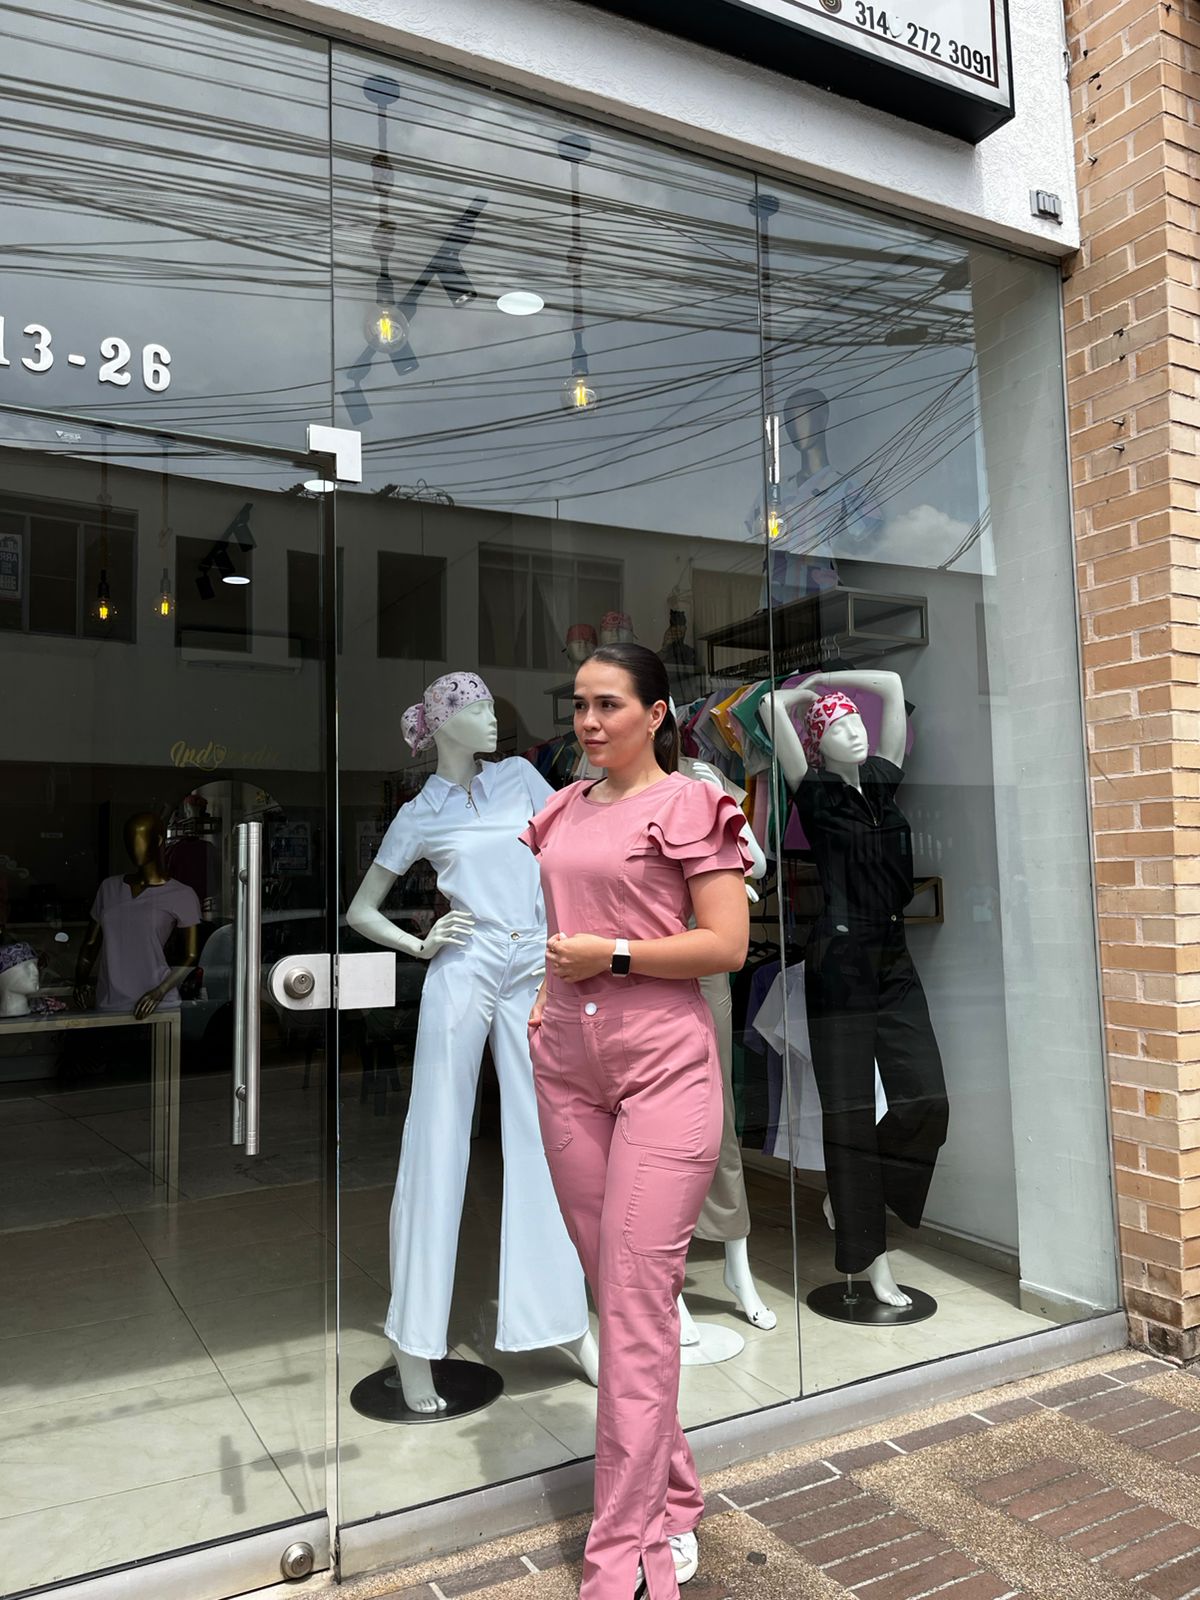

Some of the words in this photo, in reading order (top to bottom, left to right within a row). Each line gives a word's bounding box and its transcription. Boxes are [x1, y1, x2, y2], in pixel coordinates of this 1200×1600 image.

[855, 1, 889, 35] 314
[907, 22, 942, 57] 272
[948, 40, 992, 78] 3091
